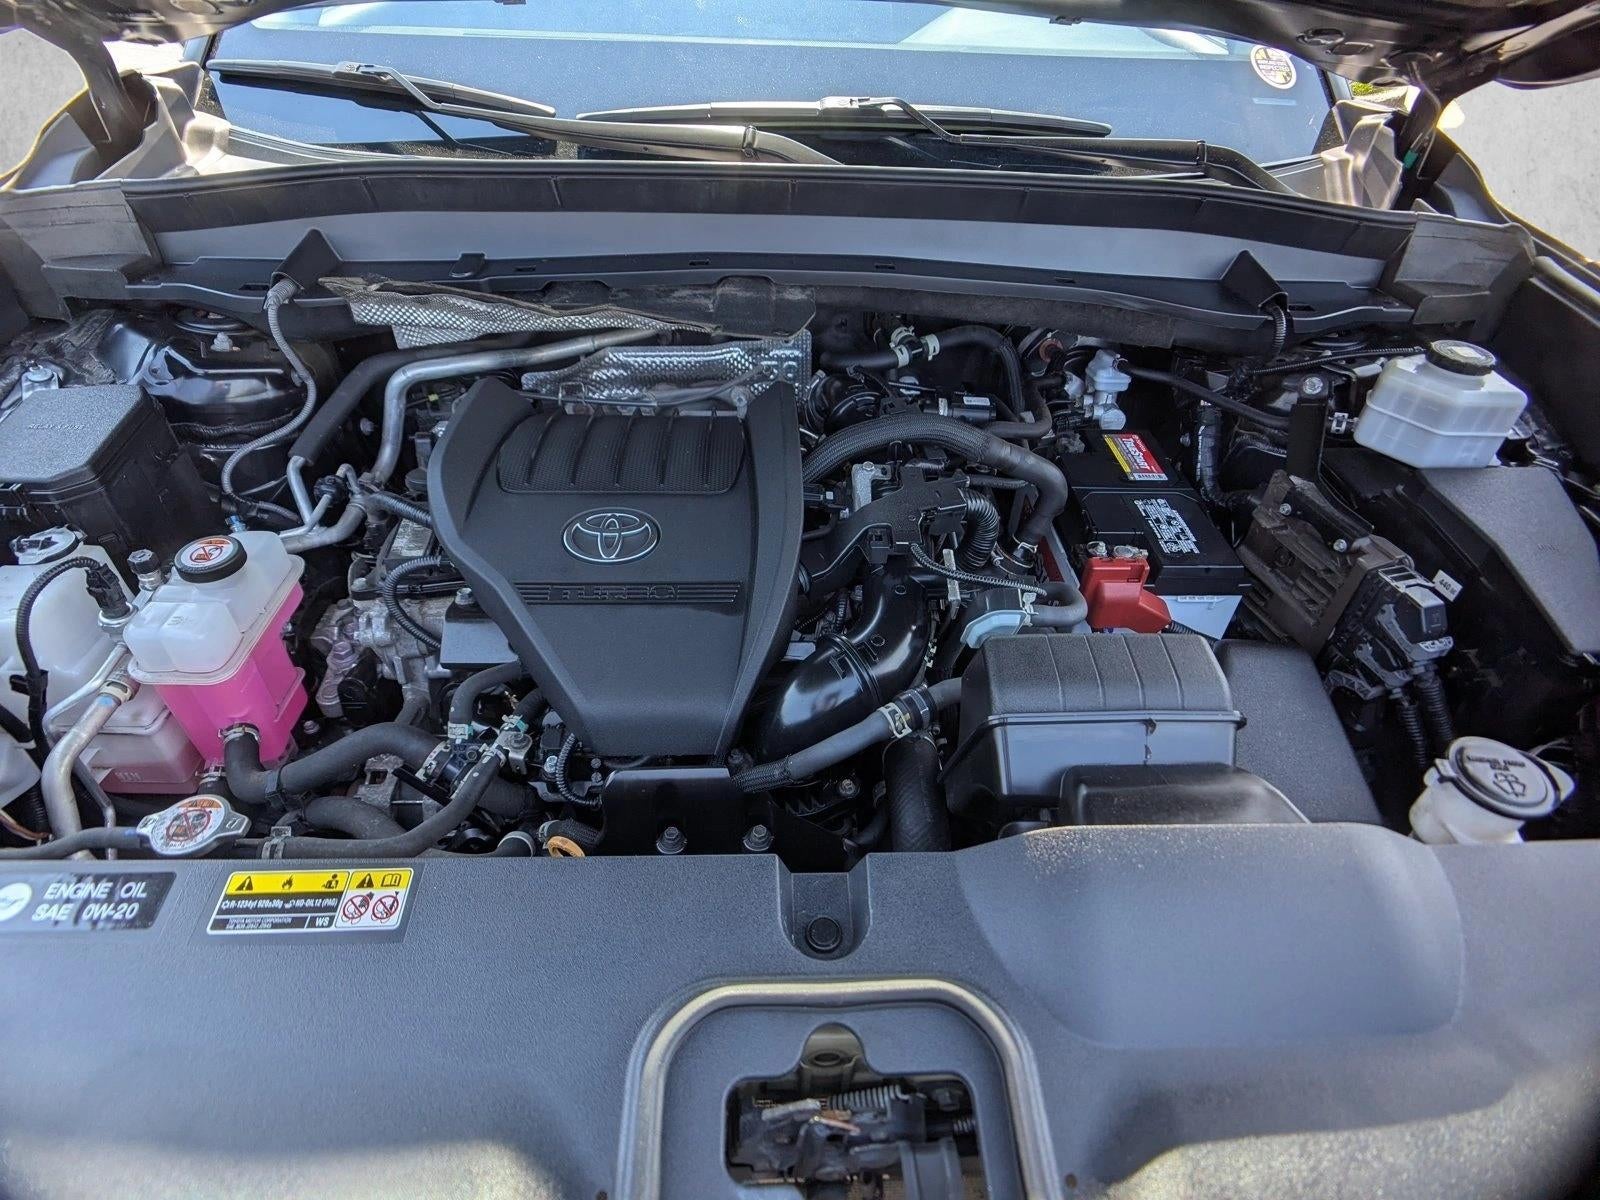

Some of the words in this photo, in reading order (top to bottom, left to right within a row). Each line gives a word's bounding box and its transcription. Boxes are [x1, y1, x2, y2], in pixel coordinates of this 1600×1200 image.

[43, 882, 113, 900] ENGINE
[120, 881, 148, 898] OIL
[31, 903, 74, 921] SAE
[81, 903, 139, 920] 0W-20
[315, 917, 329, 927] WS
